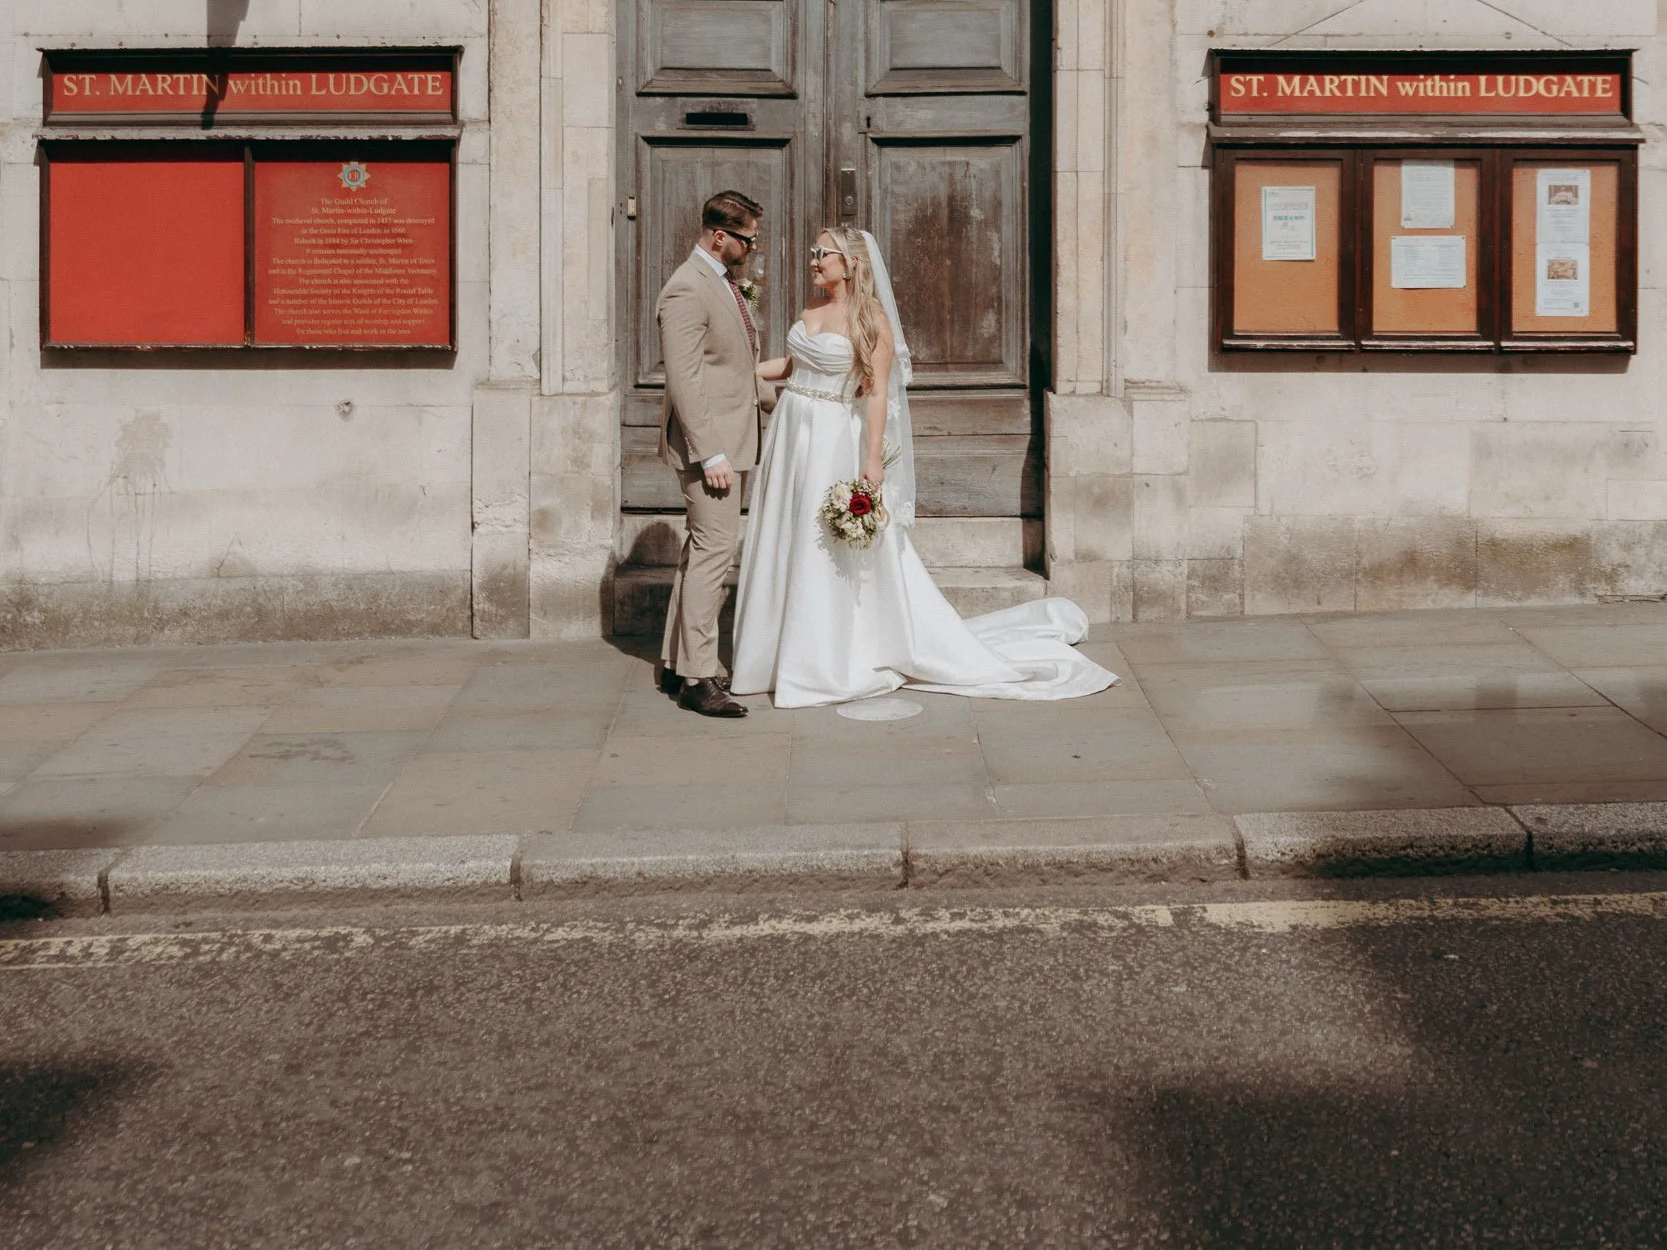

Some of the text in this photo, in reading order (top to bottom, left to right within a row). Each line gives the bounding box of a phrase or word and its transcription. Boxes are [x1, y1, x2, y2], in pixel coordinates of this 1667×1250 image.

[63, 73, 443, 96] ST. MARTIN within LUDGATE
[1230, 75, 1612, 97] ST. MARTIN within LUDGATE
